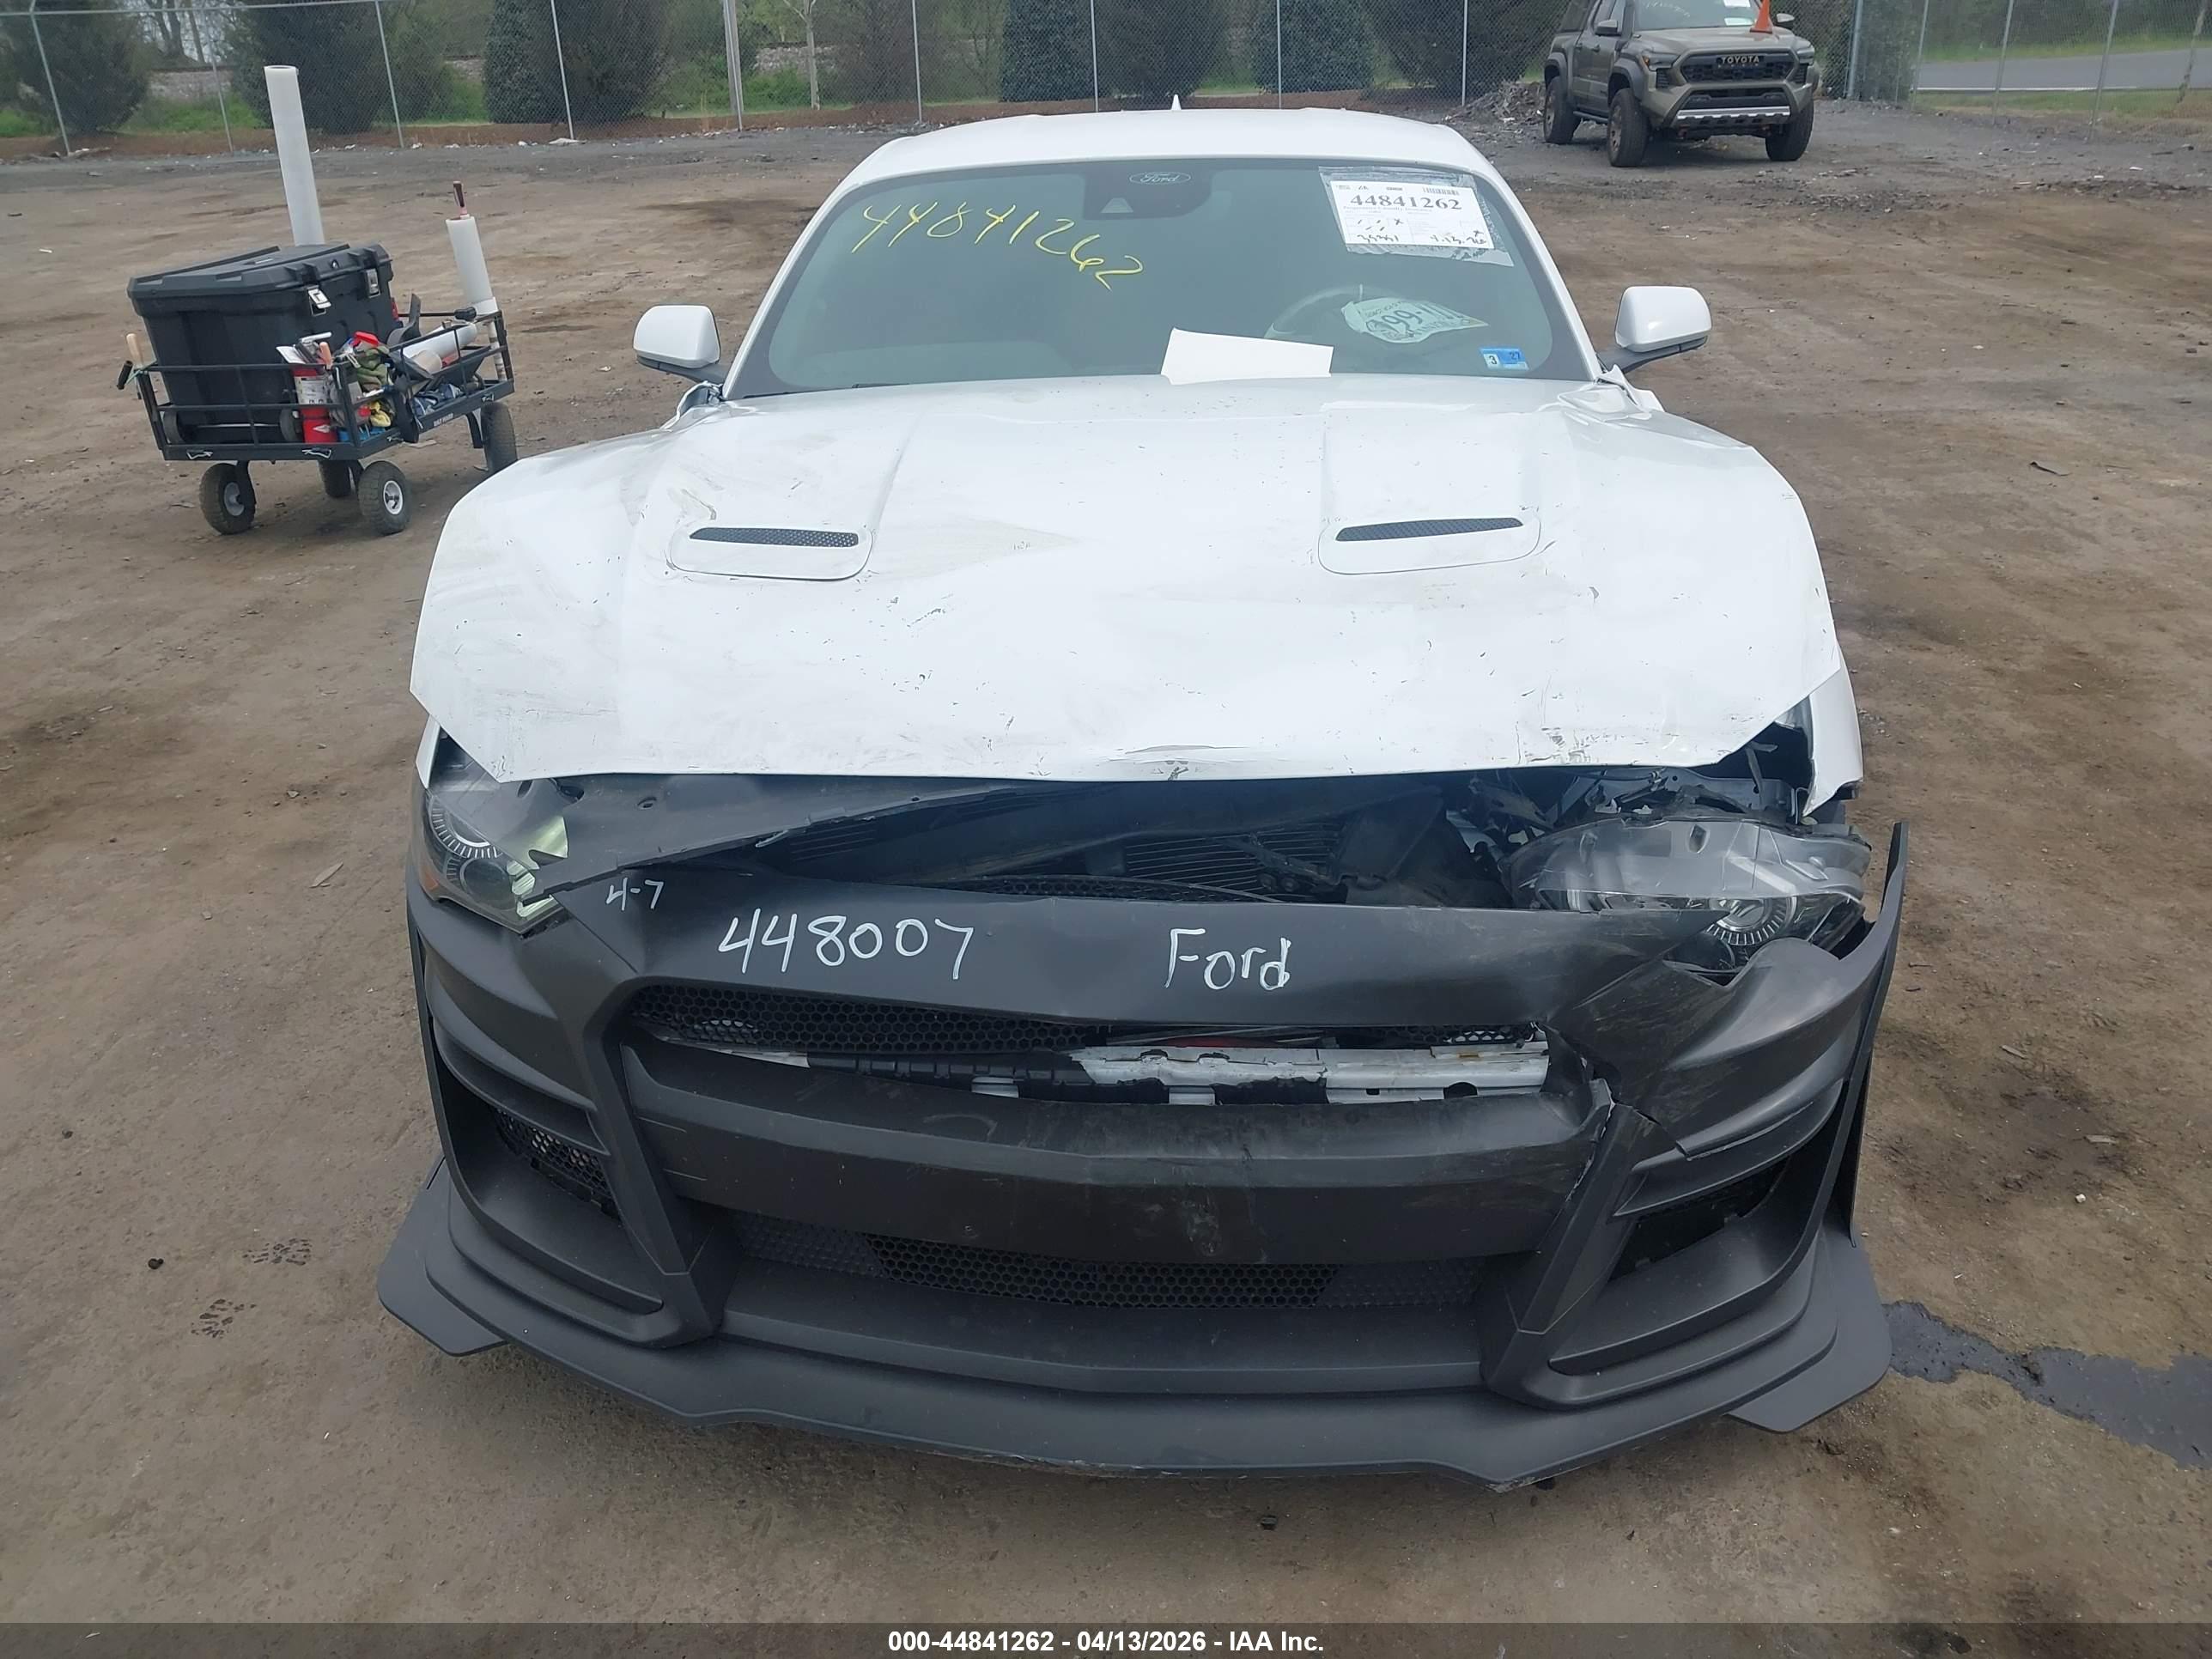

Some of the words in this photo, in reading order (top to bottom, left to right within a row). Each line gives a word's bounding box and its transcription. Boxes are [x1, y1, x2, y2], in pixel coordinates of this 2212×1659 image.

[1721, 55, 1759, 64] TOYOTA
[1350, 194, 1462, 210] 44841262
[852, 201, 1144, 291] 44841262
[1488, 355, 1498, 365] 3
[605, 877, 664, 911] 4-7
[718, 908, 974, 981] 448007
[1164, 927, 1292, 991] Ford
